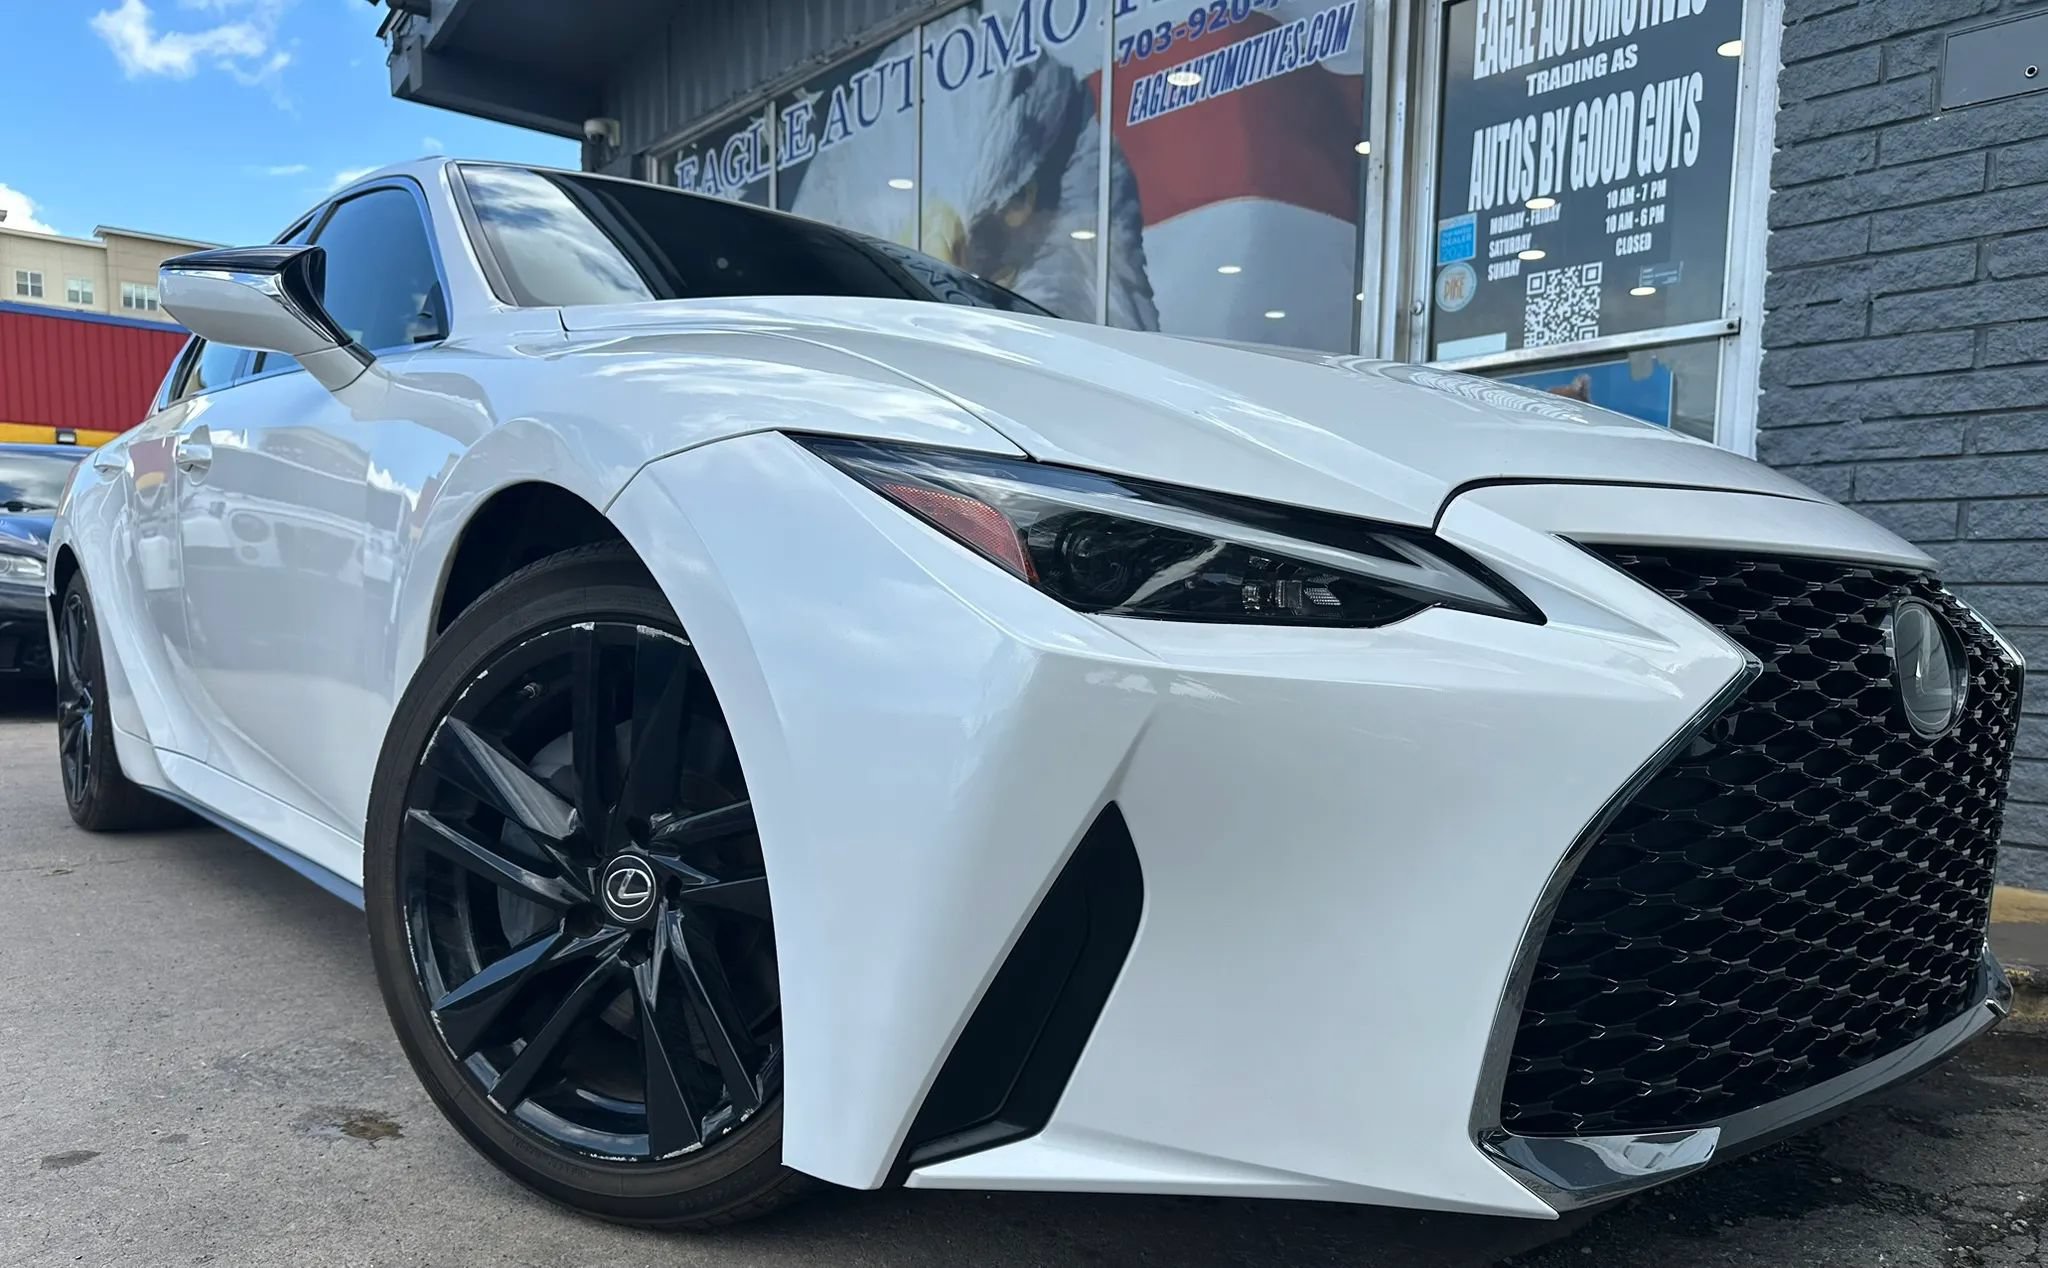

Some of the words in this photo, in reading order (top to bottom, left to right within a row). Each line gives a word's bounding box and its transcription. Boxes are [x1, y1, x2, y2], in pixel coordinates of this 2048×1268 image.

[1119, 0, 1280, 67] 703-920-
[1473, 0, 1538, 80] EAGLE
[1127, 2, 1358, 125] EAGLEAUTOMOTIVES.COM
[1526, 53, 1608, 97] TRADING
[1610, 43, 1639, 73] AS
[675, 101, 817, 196] EAGLE
[819, 0, 1137, 149] AUTOMO
[1468, 114, 1537, 212] AUTOS
[1537, 106, 1571, 197] BY
[1570, 90, 1635, 192] GOOD
[1637, 72, 1704, 177] GUYS
[1606, 189, 1619, 210] 10
[1619, 185, 1636, 207] AM
[1641, 183, 1648, 202] 7
[1650, 178, 1667, 200] PM
[1489, 210, 1526, 236] MONDAY
[1530, 202, 1562, 227] FRIDAY
[1605, 213, 1618, 234] 10
[1617, 210, 1635, 232] AM
[1640, 207, 1648, 227] 6
[1648, 203, 1665, 225] PM
[1488, 232, 1533, 259] SATURDAY
[1615, 231, 1653, 257] CLOSED
[1487, 258, 1521, 282] SUNDAY
